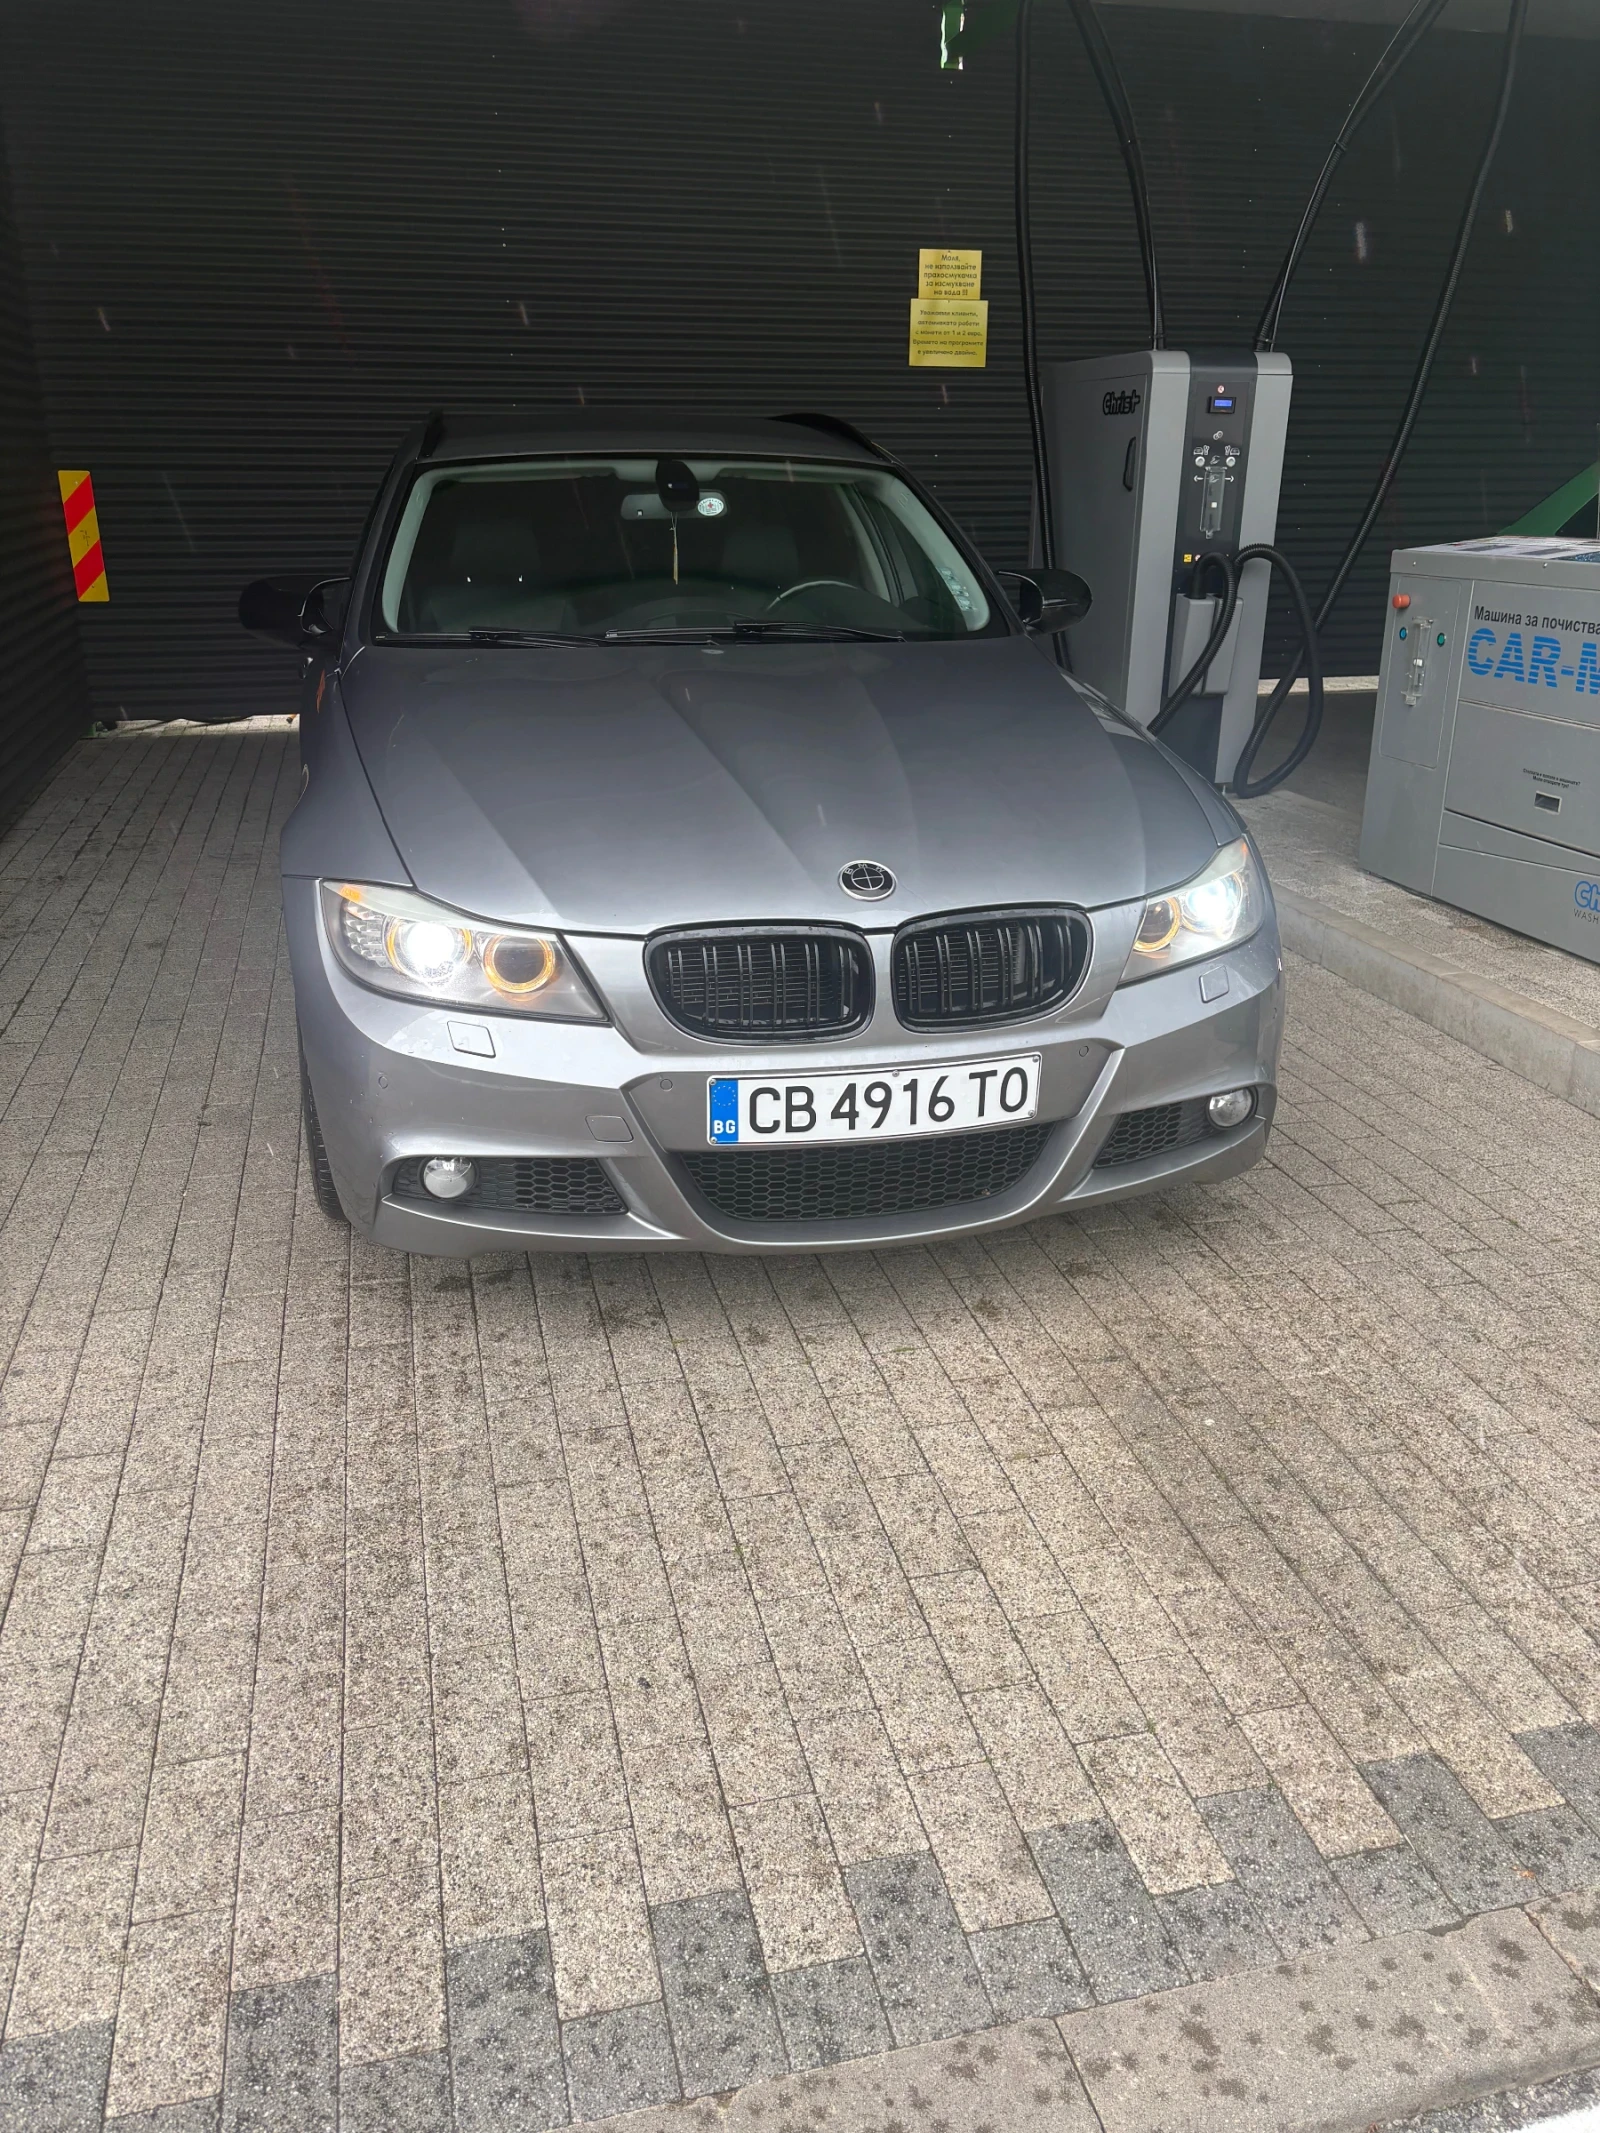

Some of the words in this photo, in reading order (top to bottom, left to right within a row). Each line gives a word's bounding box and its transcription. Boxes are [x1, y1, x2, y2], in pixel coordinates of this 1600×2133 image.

[941, 254, 961, 262] Моля,
[934, 262, 977, 270] използвайте
[1102, 389, 1141, 415] Christ
[1474, 605, 1522, 625] Машина
[1524, 615, 1539, 627] за
[844, 863, 886, 875] BMW
[1573, 908, 1599, 925] WASH
[749, 1085, 817, 1134] CB
[830, 1075, 956, 1131] 4916
[968, 1067, 1029, 1118] TO
[713, 1120, 736, 1134] BG
